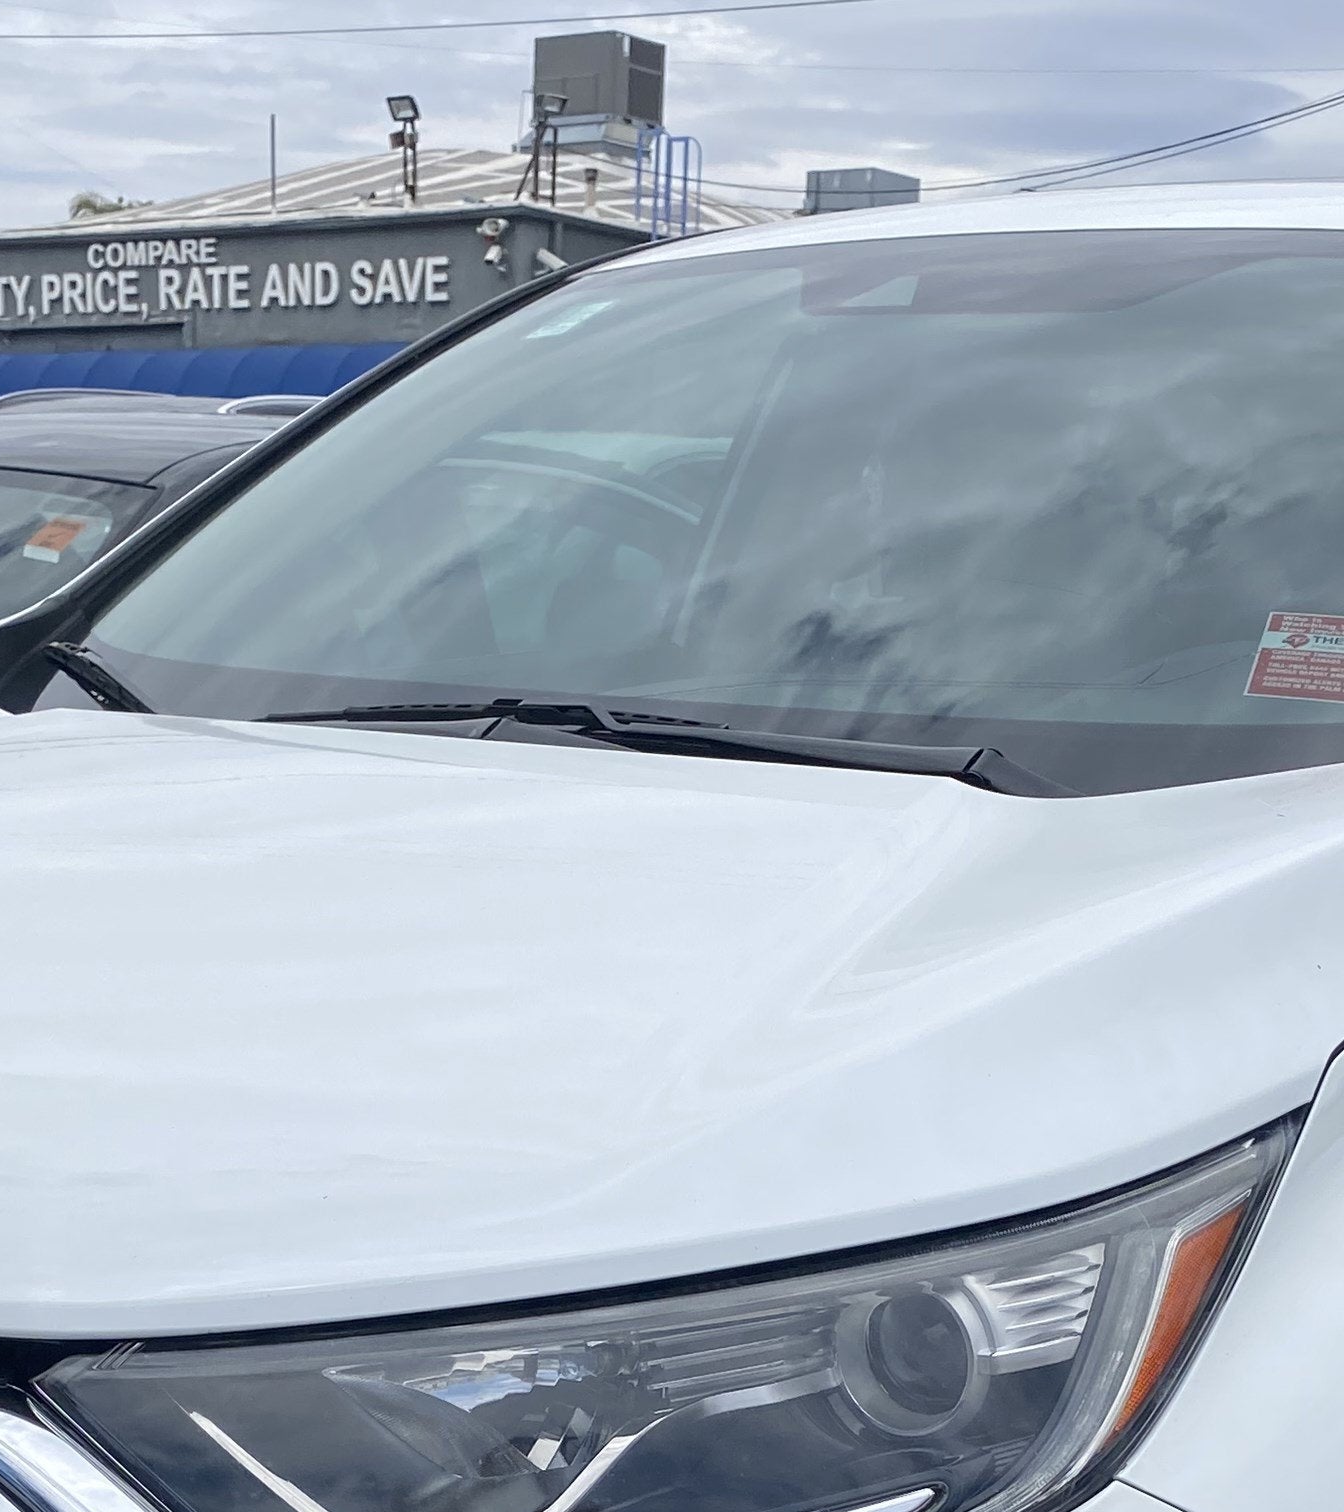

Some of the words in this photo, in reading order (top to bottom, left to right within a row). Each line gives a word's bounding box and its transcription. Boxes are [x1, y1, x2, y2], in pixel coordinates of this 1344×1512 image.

[87, 238, 218, 269] COMPARE
[41, 269, 149, 322] PRICE,
[158, 265, 251, 311] RATE
[260, 262, 339, 308] AND
[350, 256, 450, 306] SAVE
